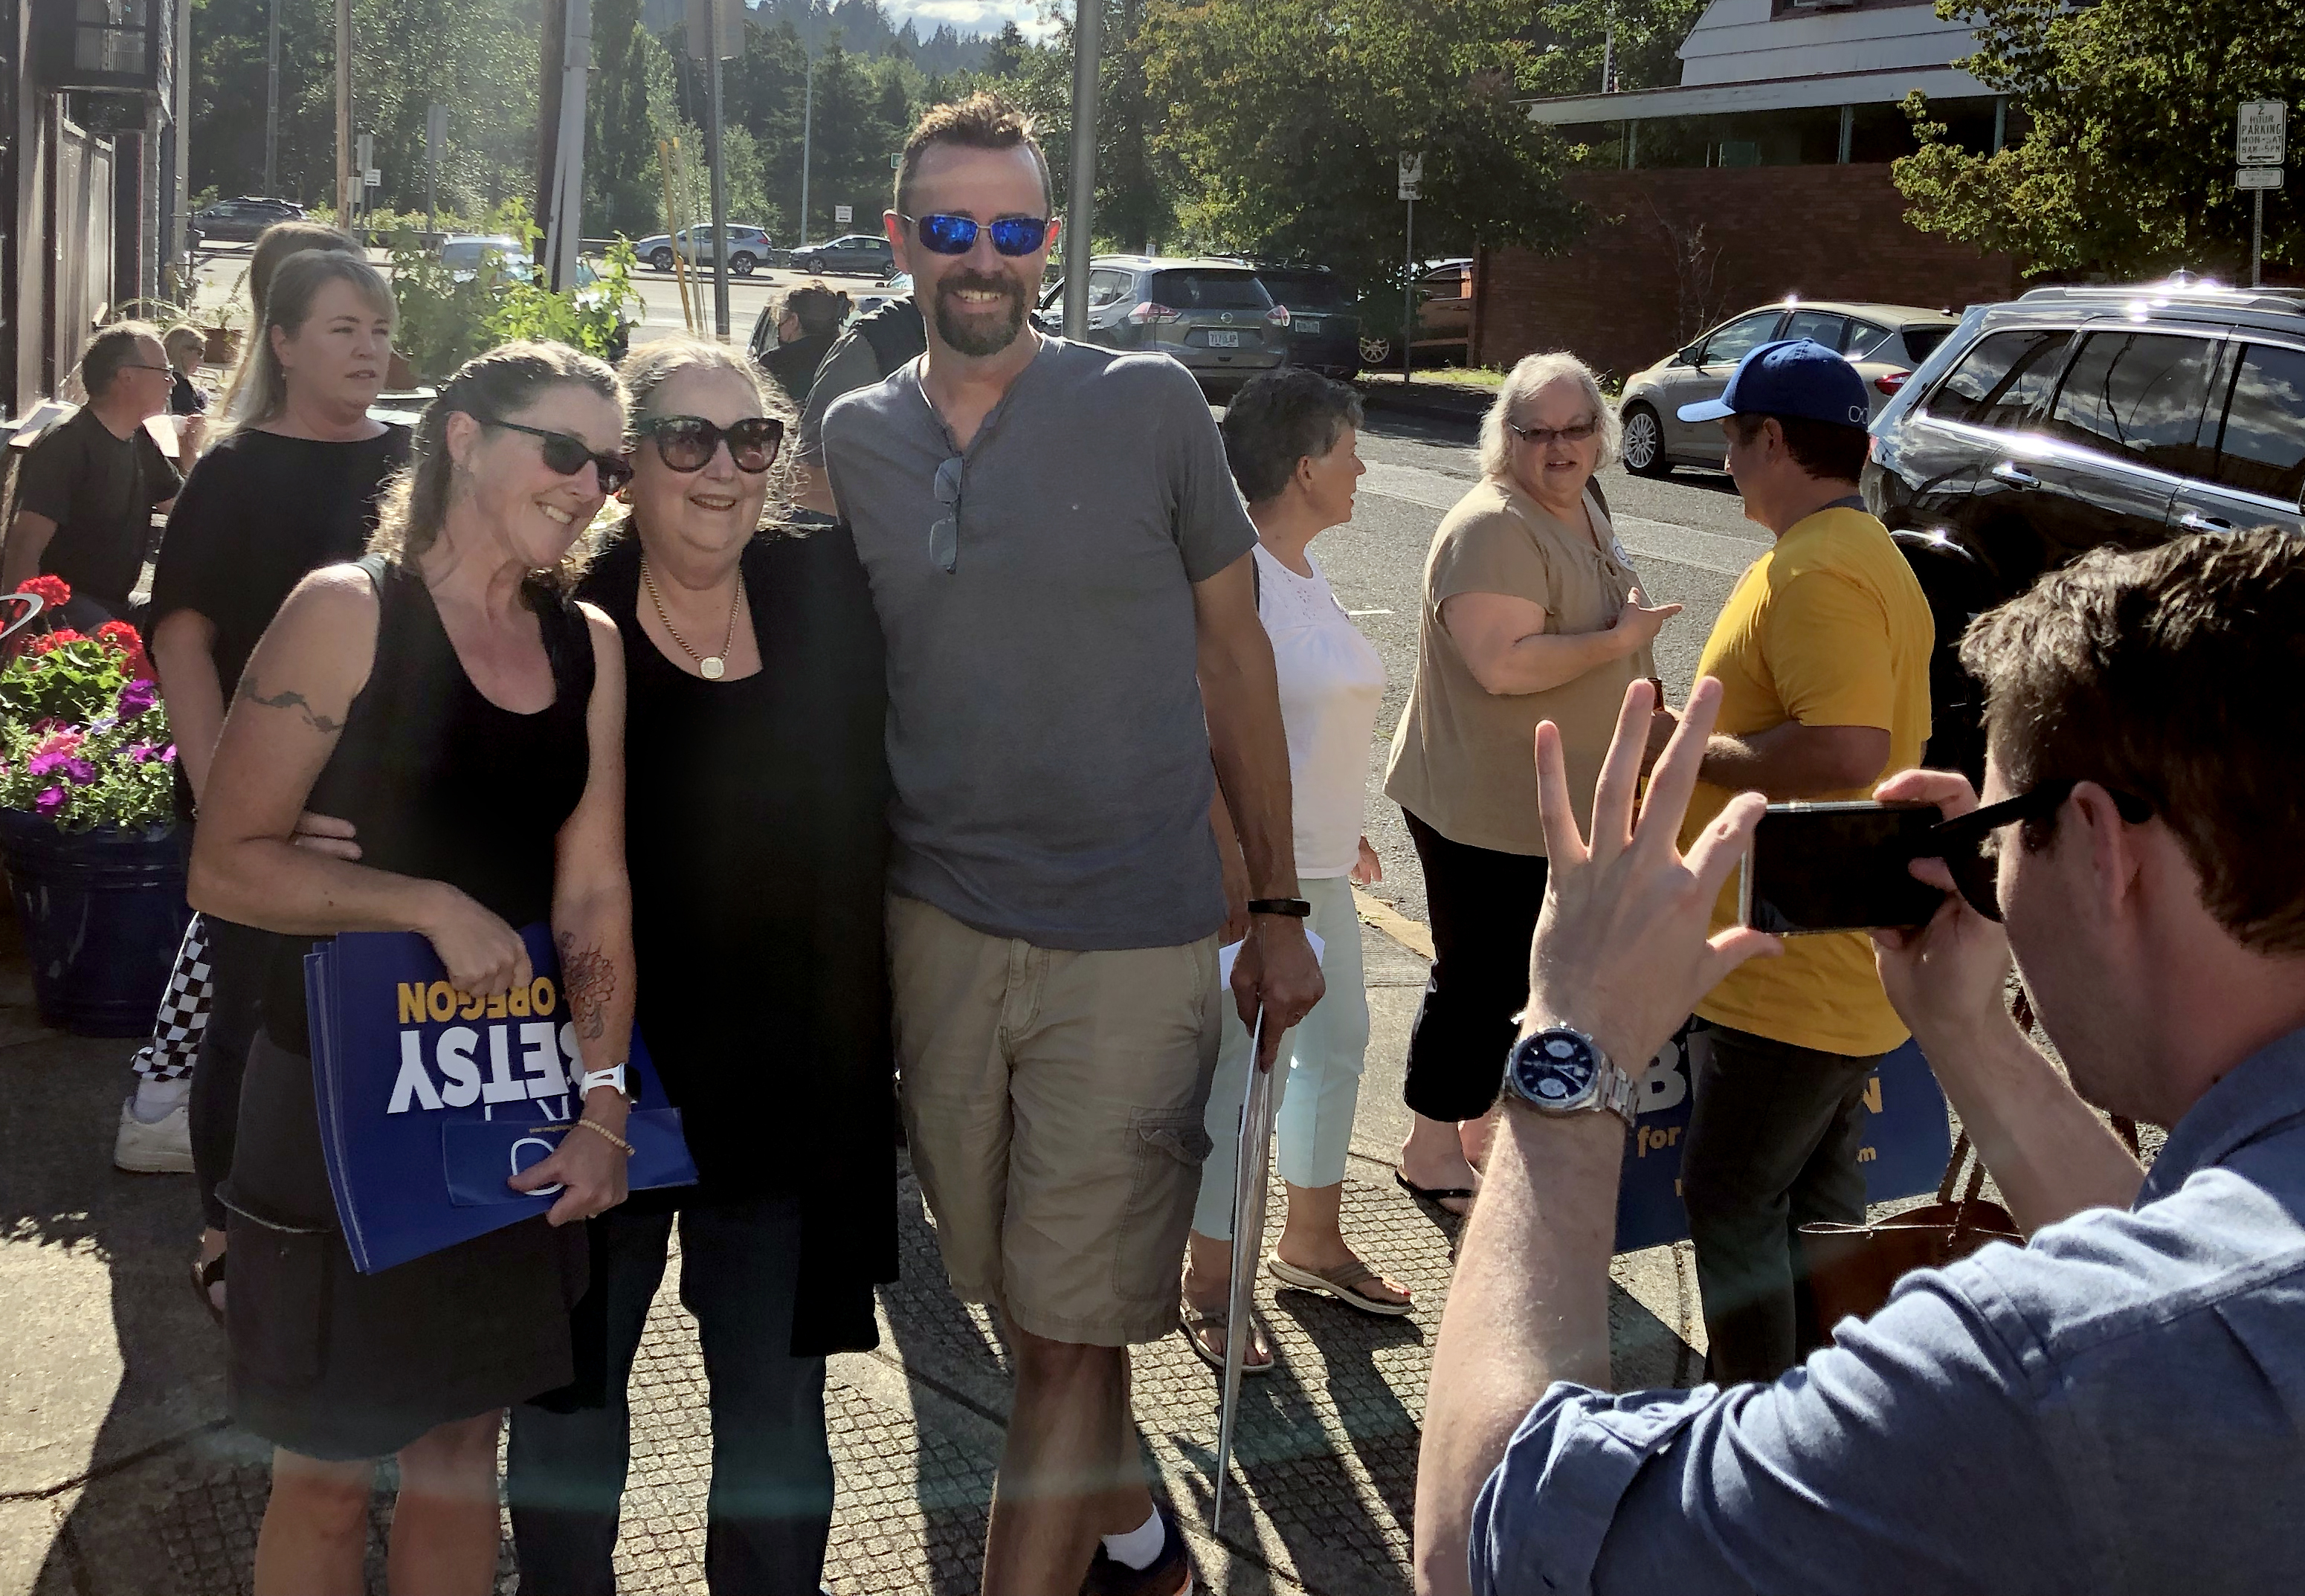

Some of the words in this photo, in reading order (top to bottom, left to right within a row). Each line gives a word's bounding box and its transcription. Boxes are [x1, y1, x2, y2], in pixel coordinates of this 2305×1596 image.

[2241, 123, 2281, 135] PARKING
[2250, 115, 2275, 124] HOUR
[397, 977, 556, 1024] OREGON
[1637, 1125, 1682, 1158] for
